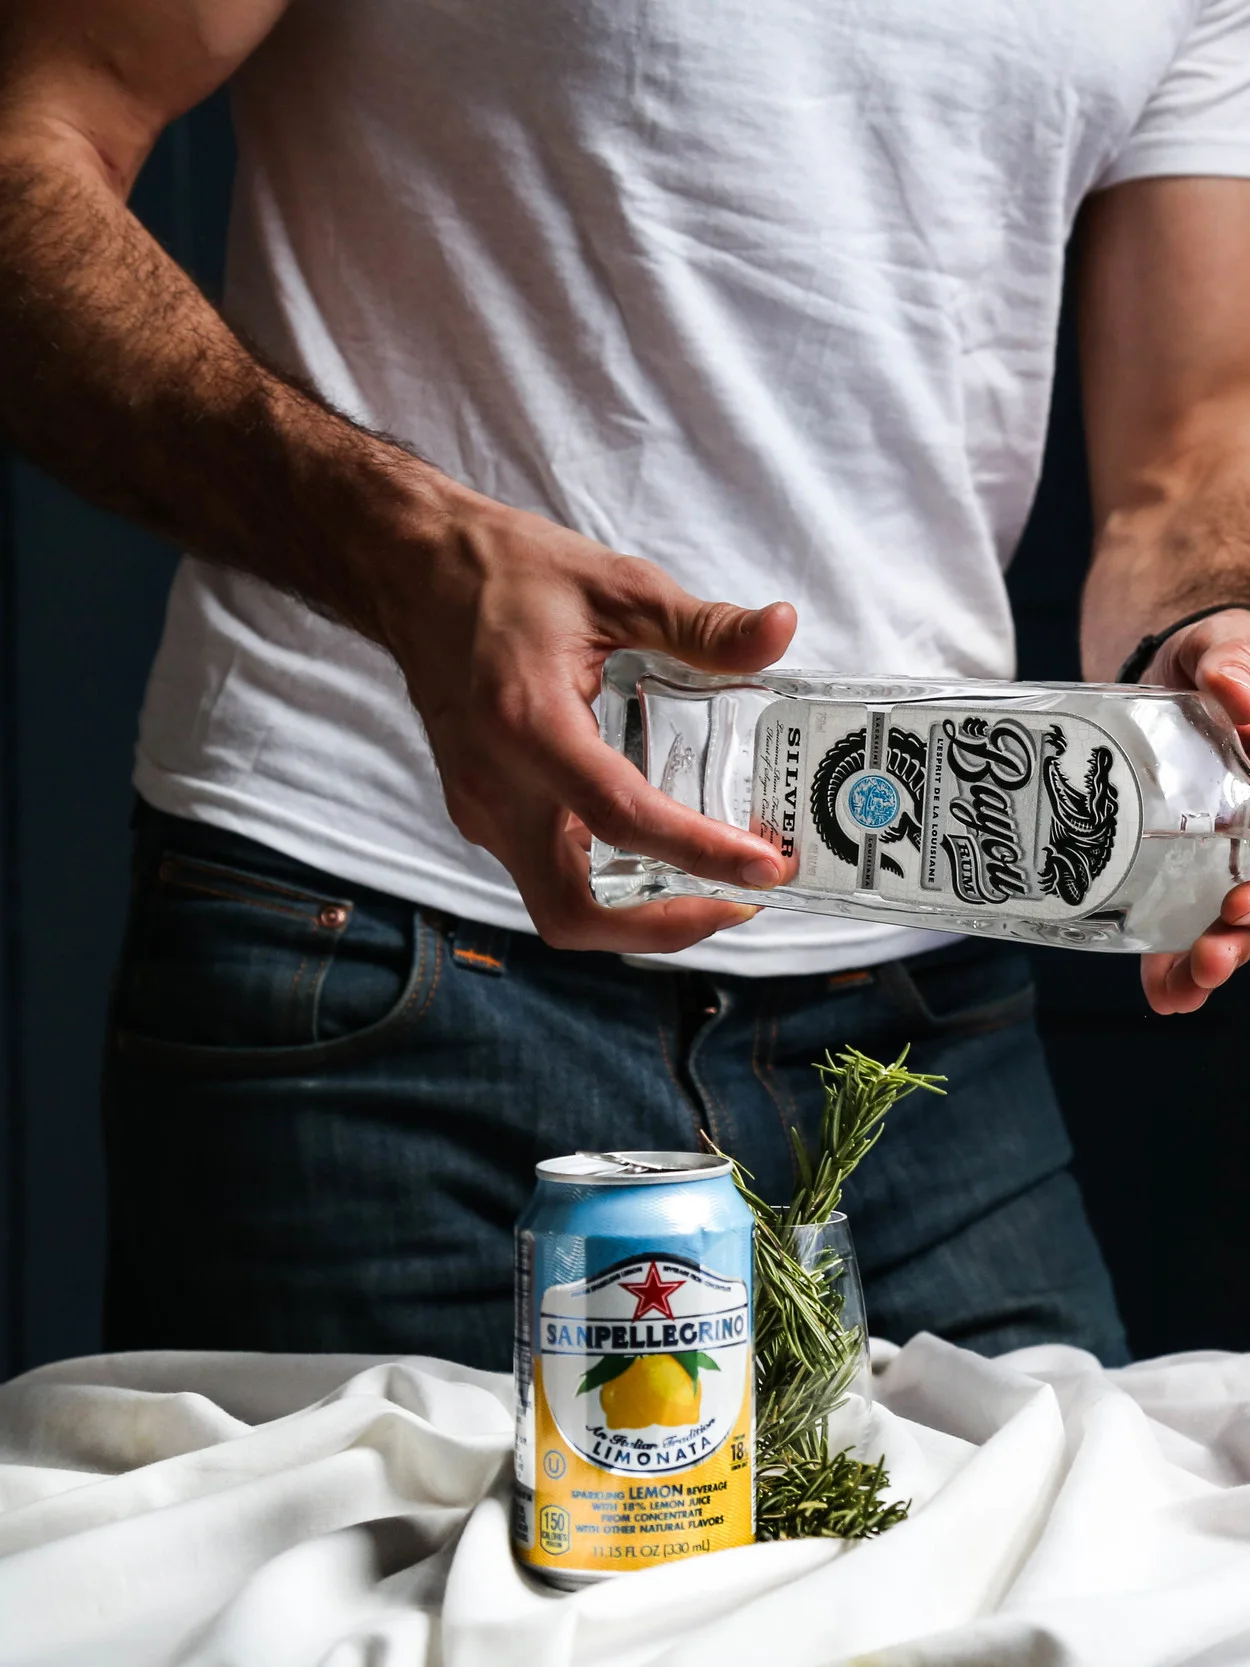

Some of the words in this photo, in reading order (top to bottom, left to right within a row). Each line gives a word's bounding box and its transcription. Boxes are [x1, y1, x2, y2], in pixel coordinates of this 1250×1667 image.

[764, 726, 774, 756] Heart
[773, 720, 784, 765] Louisiana
[934, 738, 944, 784] L'ESPRIT
[759, 767, 771, 796] Sugar
[772, 768, 781, 793] Rum
[781, 727, 801, 858] SILVER
[933, 788, 942, 801] DE
[770, 795, 780, 823] Fresh
[932, 805, 940, 819] LA
[943, 719, 1037, 897] Bayou
[864, 838, 873, 888] LOUISIANA
[928, 824, 938, 883] LOUISIANE
[957, 842, 976, 894] RUM
[546, 1315, 744, 1350] SANPELLEGRINO
[592, 1436, 712, 1466] LIMONATA
[629, 1484, 684, 1500] LEMON
[686, 1481, 728, 1496] BEVERAGE
[650, 1499, 685, 1510] LEMON
[688, 1495, 711, 1507] JUICE
[544, 1511, 565, 1532] 150
[601, 1514, 630, 1523] FROM
[634, 1508, 703, 1523] CONCENTRATE
[603, 1524, 636, 1534] OTHER
[640, 1522, 685, 1534] NATURAL
[688, 1515, 724, 1528] FLAVORS
[640, 1544, 661, 1557] OZ
